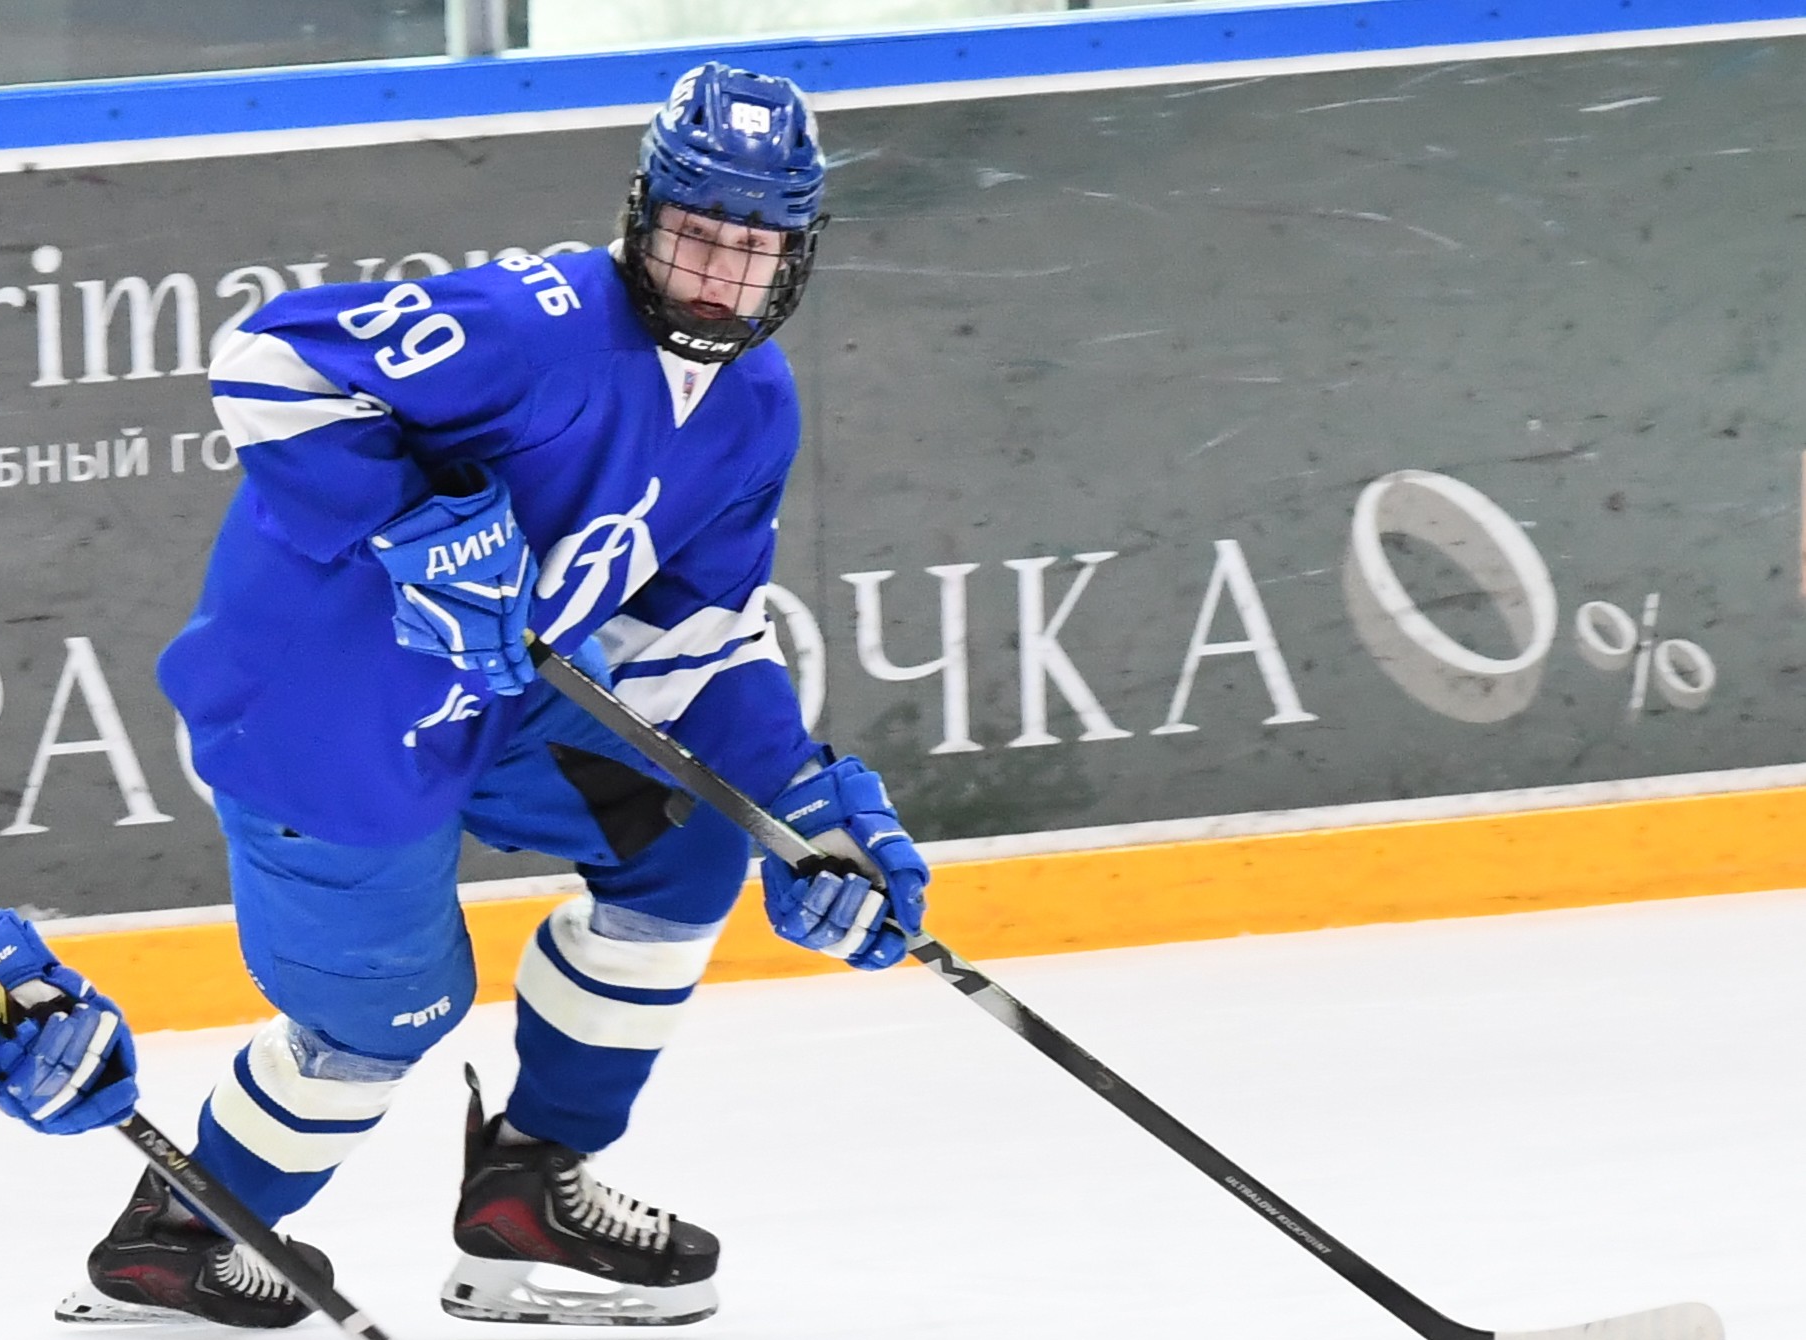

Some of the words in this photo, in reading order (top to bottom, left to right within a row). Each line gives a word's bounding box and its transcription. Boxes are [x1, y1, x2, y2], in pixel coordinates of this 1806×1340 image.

[497, 254, 582, 317] ВТБ
[337, 283, 466, 379] 89
[669, 331, 736, 353] CCM
[413, 995, 451, 1028] ВТБ
[1224, 1175, 1281, 1216] ULTRALOW
[1276, 1214, 1332, 1254] KICKPOINT
